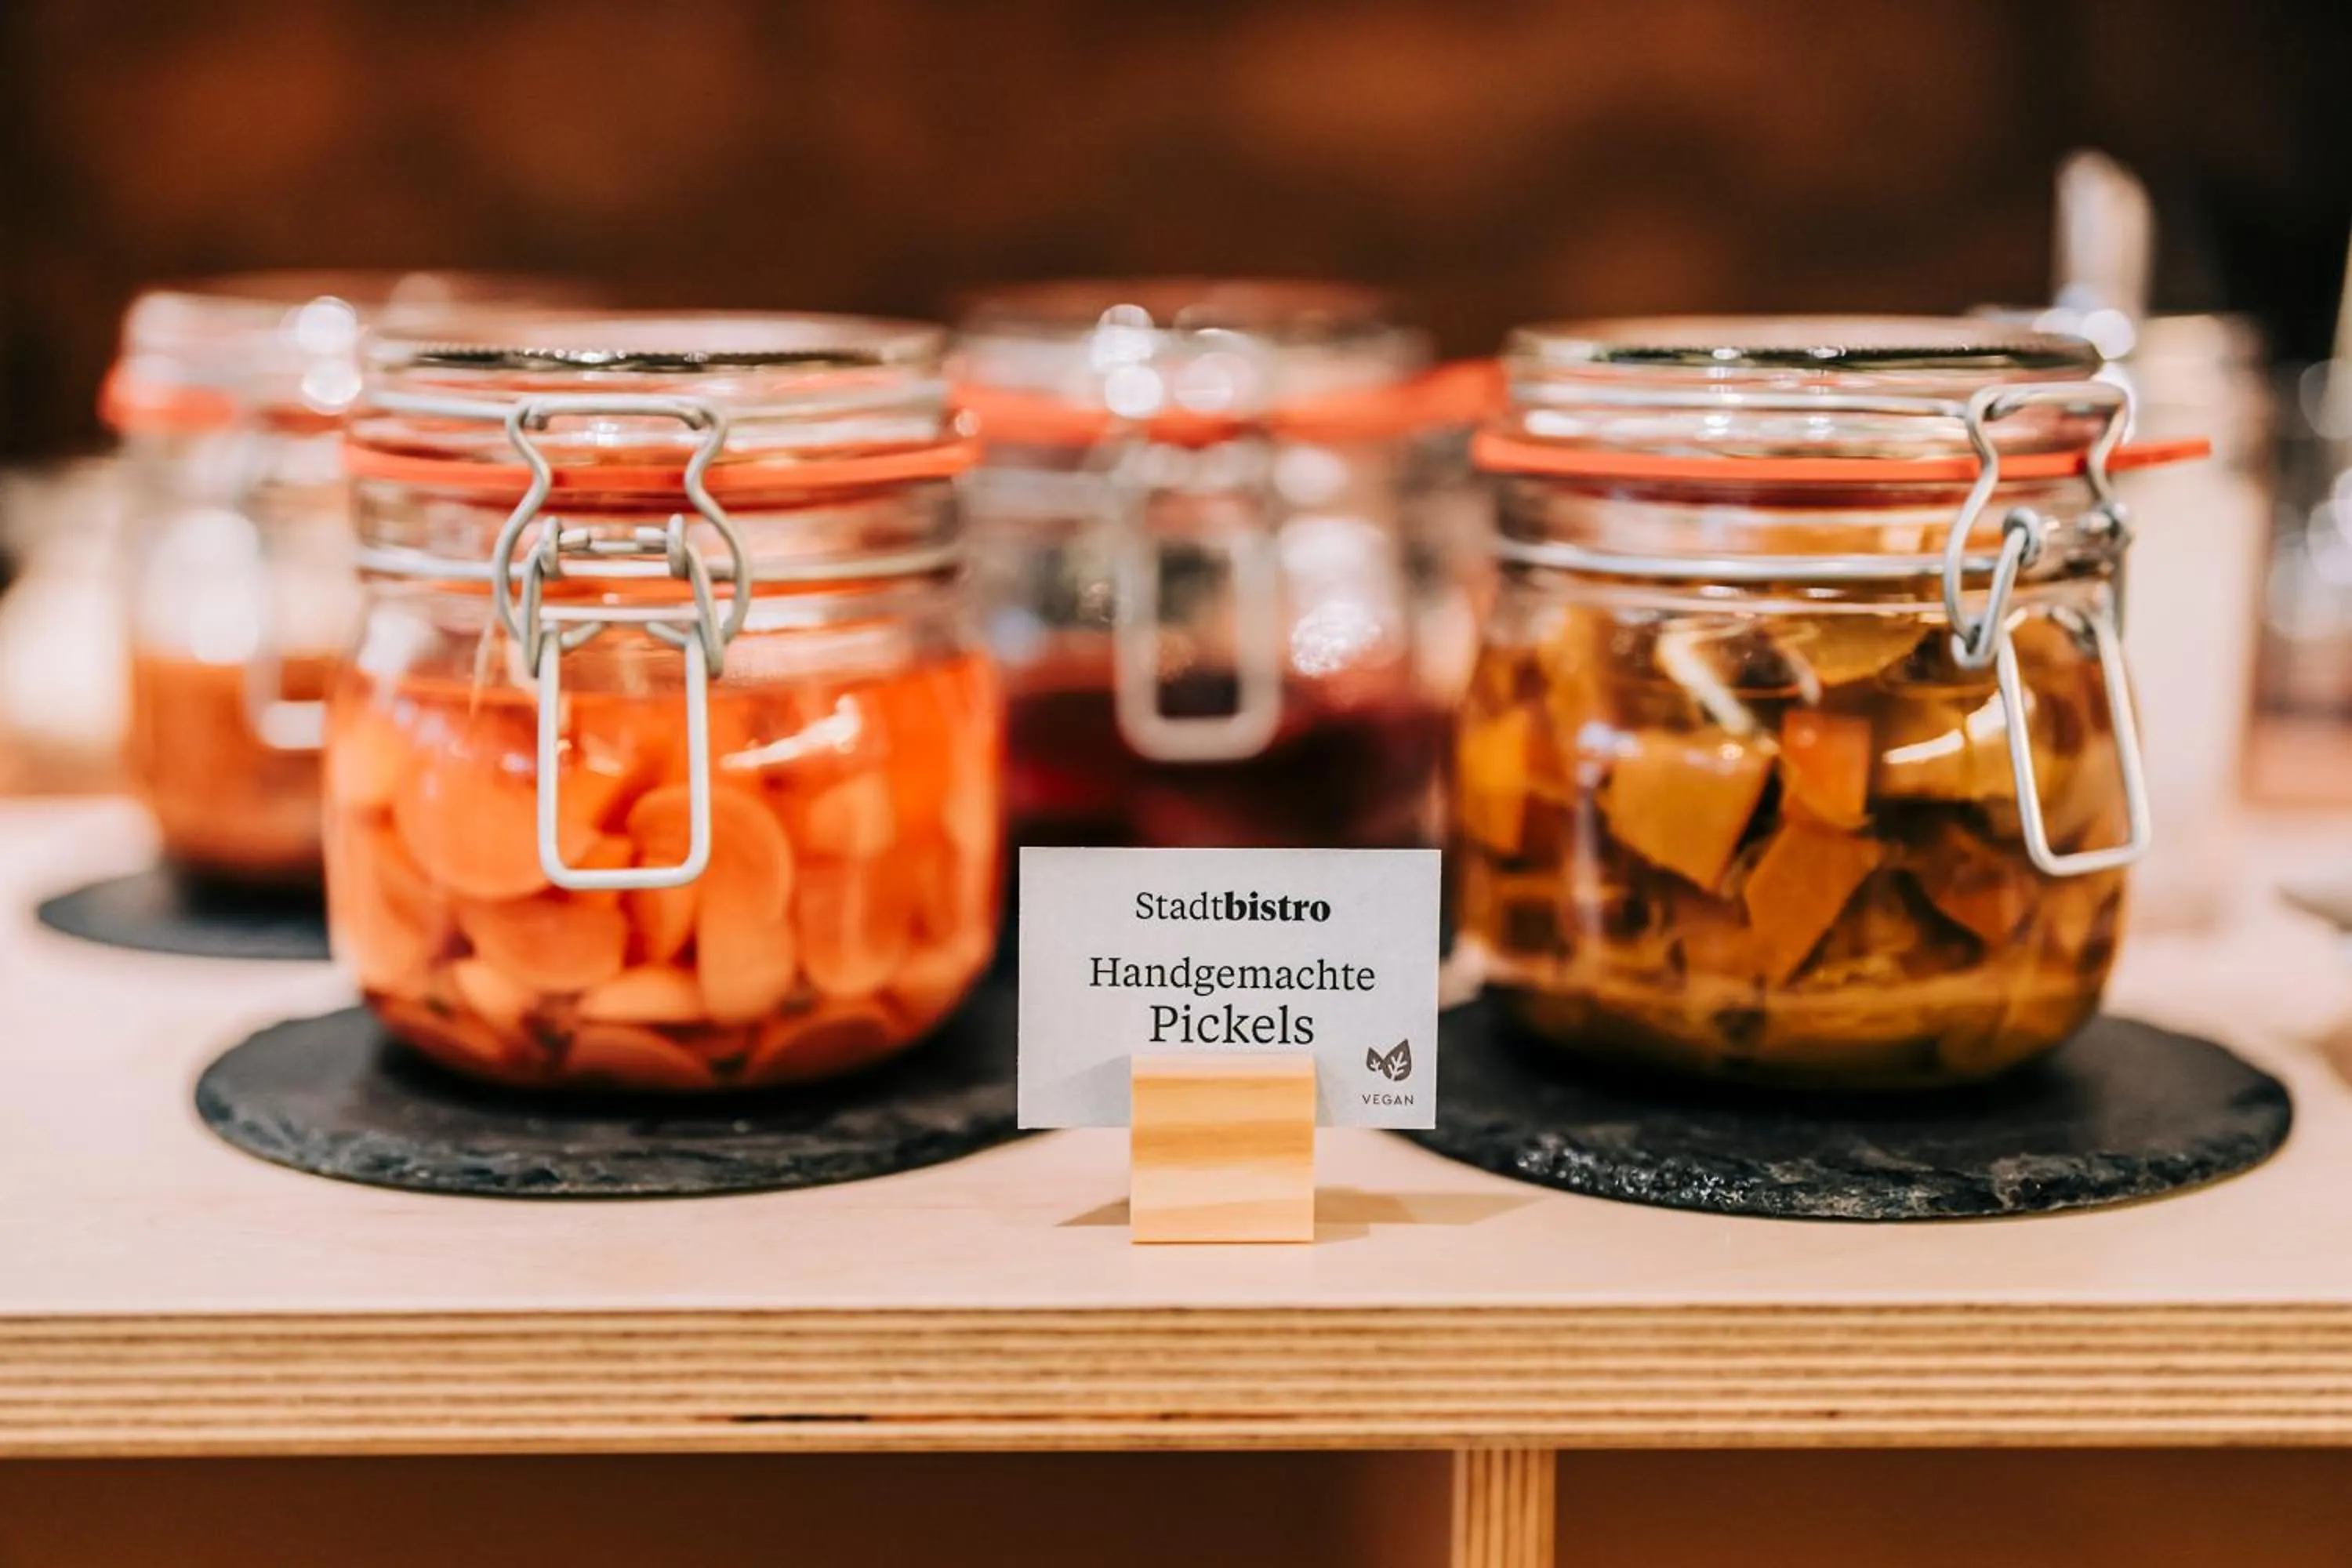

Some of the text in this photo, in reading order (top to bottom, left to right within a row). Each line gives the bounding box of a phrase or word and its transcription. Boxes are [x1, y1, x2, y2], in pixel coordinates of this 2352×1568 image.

[1135, 891, 1331, 923] Stadtbistro
[1090, 956, 1376, 996] Handgemachte
[1149, 1004, 1315, 1045] Pickels
[1361, 1094, 1415, 1105] VEGAN
